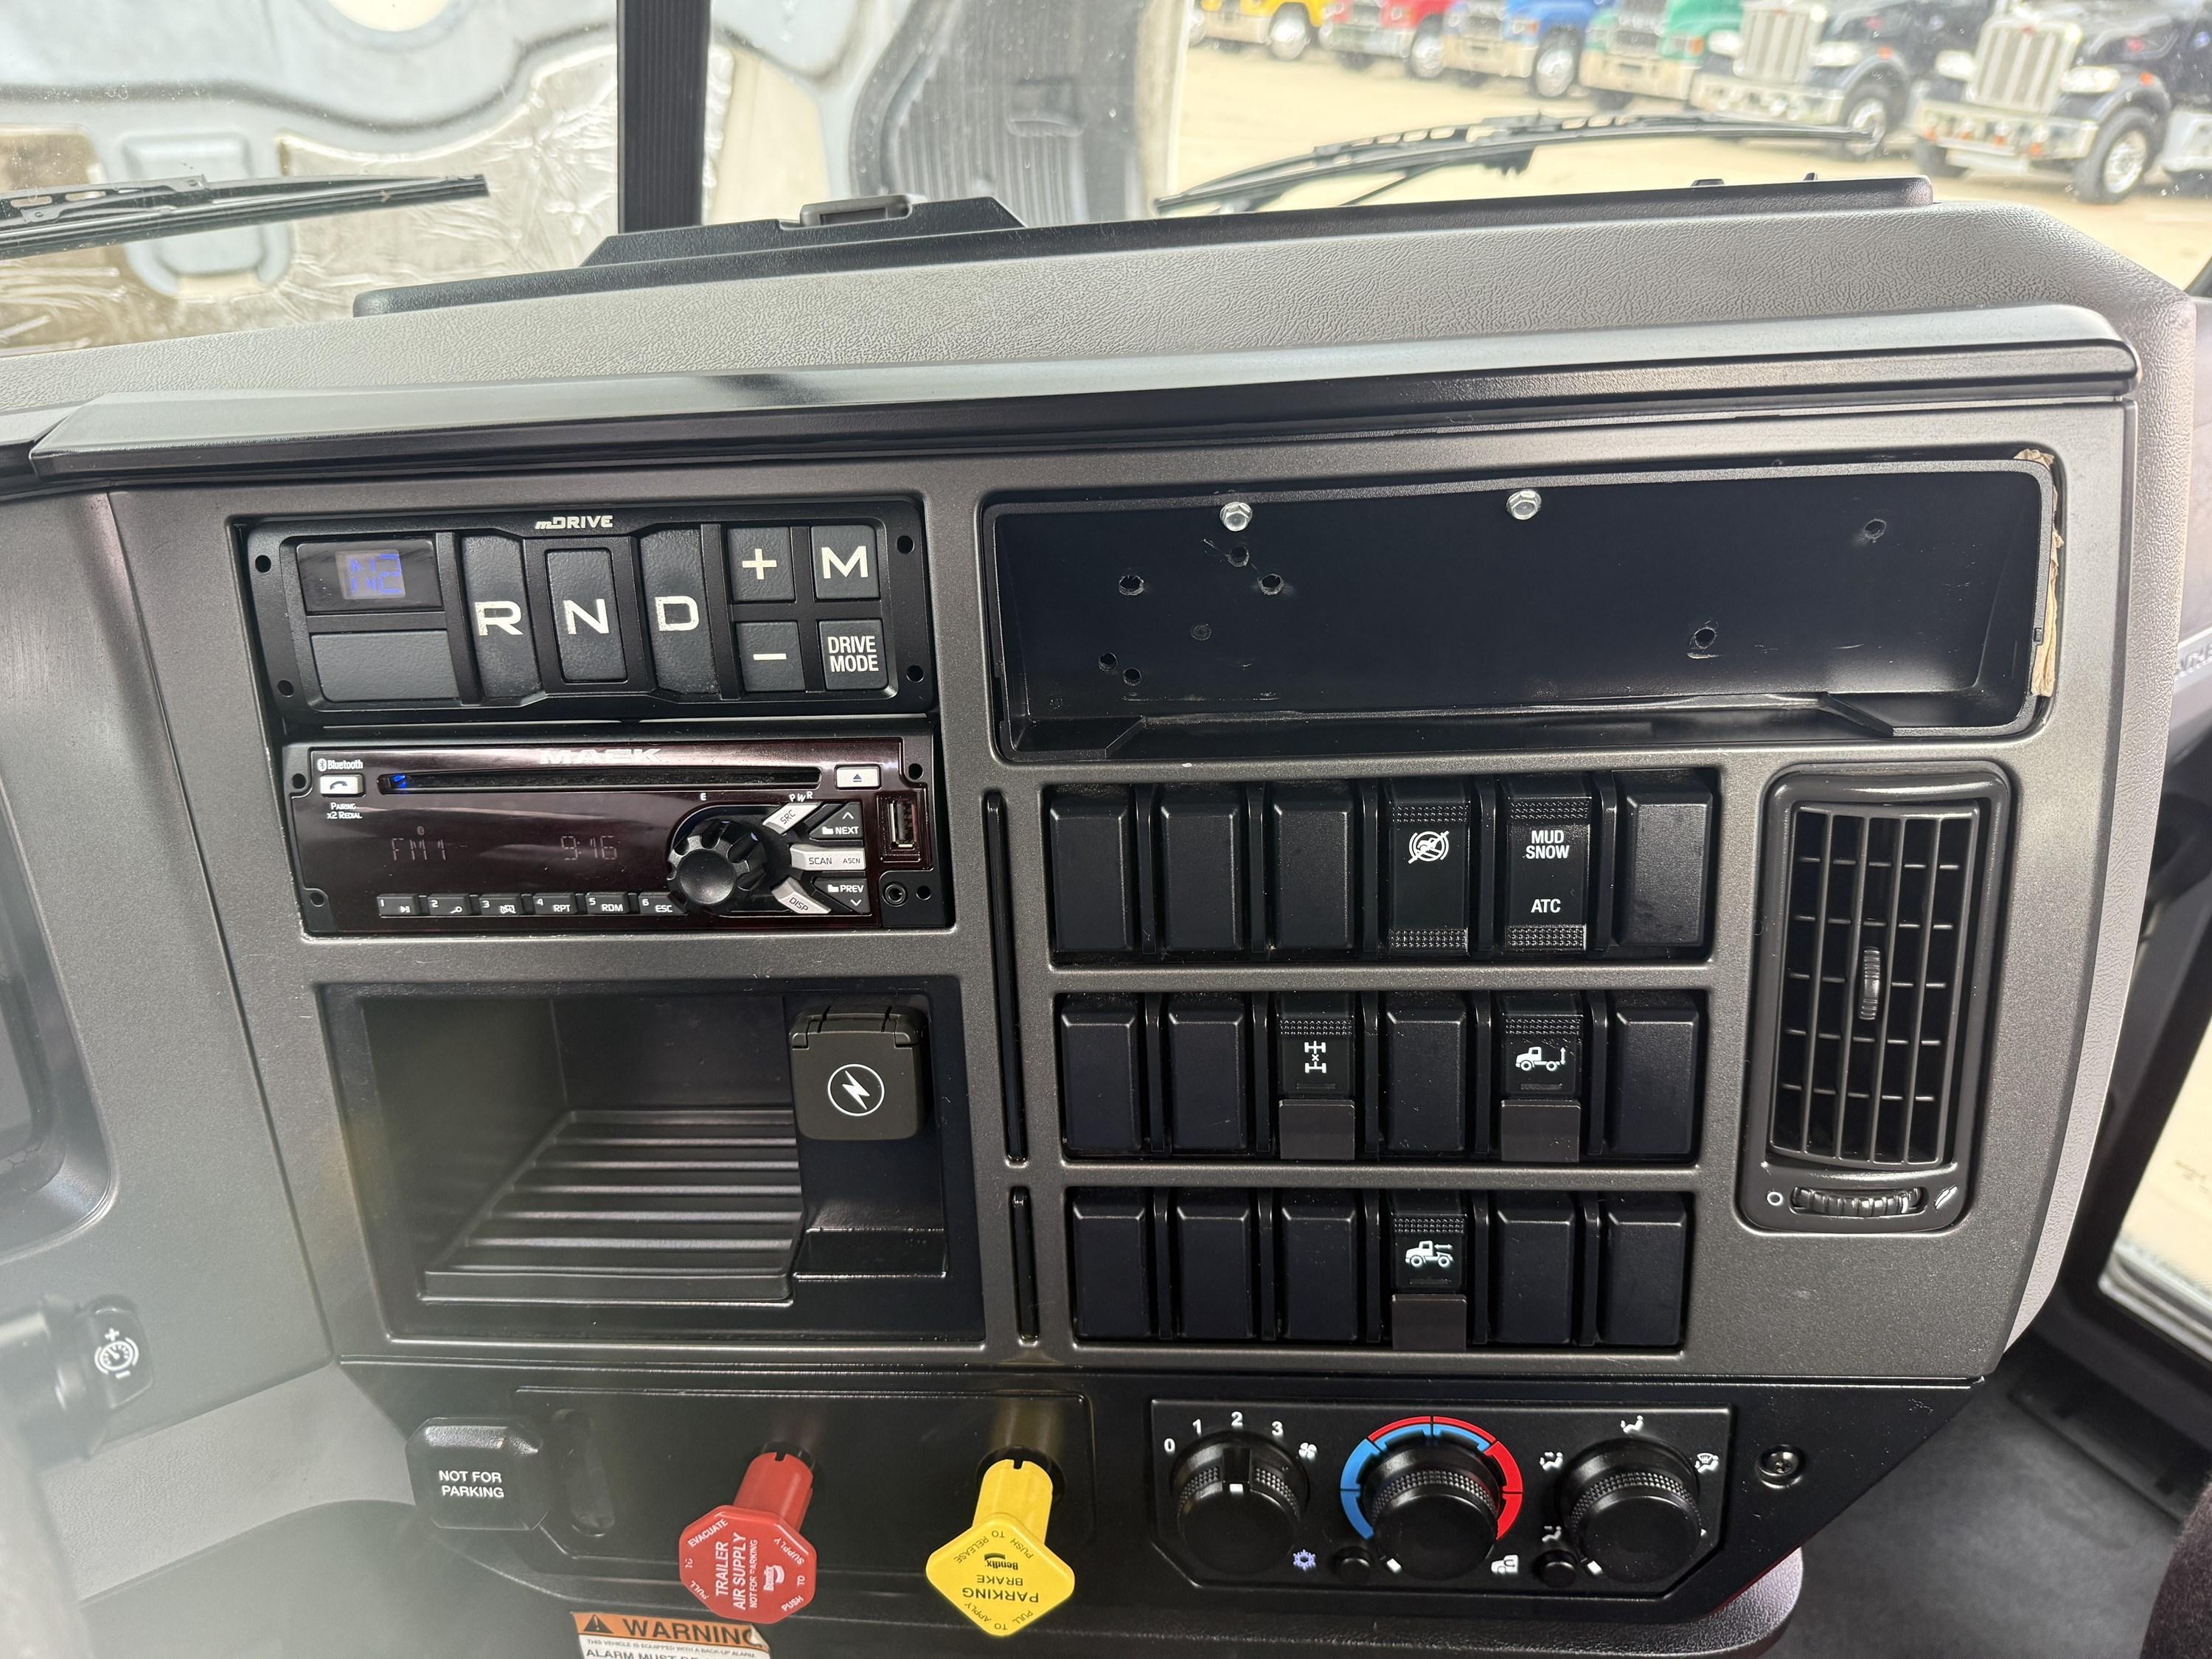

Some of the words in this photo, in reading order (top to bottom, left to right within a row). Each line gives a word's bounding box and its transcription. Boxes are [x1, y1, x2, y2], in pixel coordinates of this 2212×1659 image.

[821, 546, 869, 579] M
[474, 600, 524, 636] R
[563, 598, 611, 635] N
[655, 595, 700, 631] D
[827, 636, 876, 654] DRIVE
[830, 654, 879, 673] MODE
[327, 759, 364, 770] Bluetooth
[789, 791, 813, 802] PWR
[780, 810, 796, 824] SRC
[835, 826, 859, 835] NEXT
[1531, 830, 1564, 844] MUD
[560, 835, 618, 860] 9:16
[1526, 846, 1569, 859] SNOW
[809, 857, 832, 865] SCAN
[840, 885, 863, 893] PREV
[431, 900, 439, 908] 2
[537, 898, 543, 906] 4
[589, 897, 597, 905] 5
[602, 904, 624, 912] RDM
[642, 898, 650, 906] 6
[789, 897, 809, 911] DISP
[1531, 898, 1561, 913] ATC
[553, 905, 571, 913] RPT
[655, 905, 672, 913] ESC
[1231, 1411, 1243, 1427] 2
[1192, 1419, 1202, 1436] 1
[1272, 1421, 1284, 1437] 3
[1164, 1438, 1175, 1453] 0
[439, 1470, 468, 1482] NOT
[472, 1471, 502, 1484] FOR
[442, 1485, 504, 1498] PARKING
[687, 1518, 729, 1548] EVACUATE
[991, 1530, 1005, 1538] TO
[773, 1537, 805, 1565] SUPPLY
[953, 1536, 989, 1564] RELEASE
[1010, 1538, 1034, 1559] PUSH
[733, 1532, 746, 1586] SUPPLY
[749, 1540, 758, 1574] PARKING
[715, 1541, 729, 1596] TRAILER
[987, 1560, 1018, 1571] Bendix
[749, 1576, 758, 1592] FOR
[797, 1575, 805, 1587] TO
[976, 1574, 1023, 1586] BRAKE
[733, 1588, 746, 1610] AIR
[749, 1592, 758, 1608] NOT
[962, 1587, 1039, 1603] PARKING
[781, 1595, 804, 1612] PUSH
[964, 1602, 991, 1622] APPLY
[1012, 1610, 1034, 1624] PULL
[586, 1649, 634, 1659] ALARM
